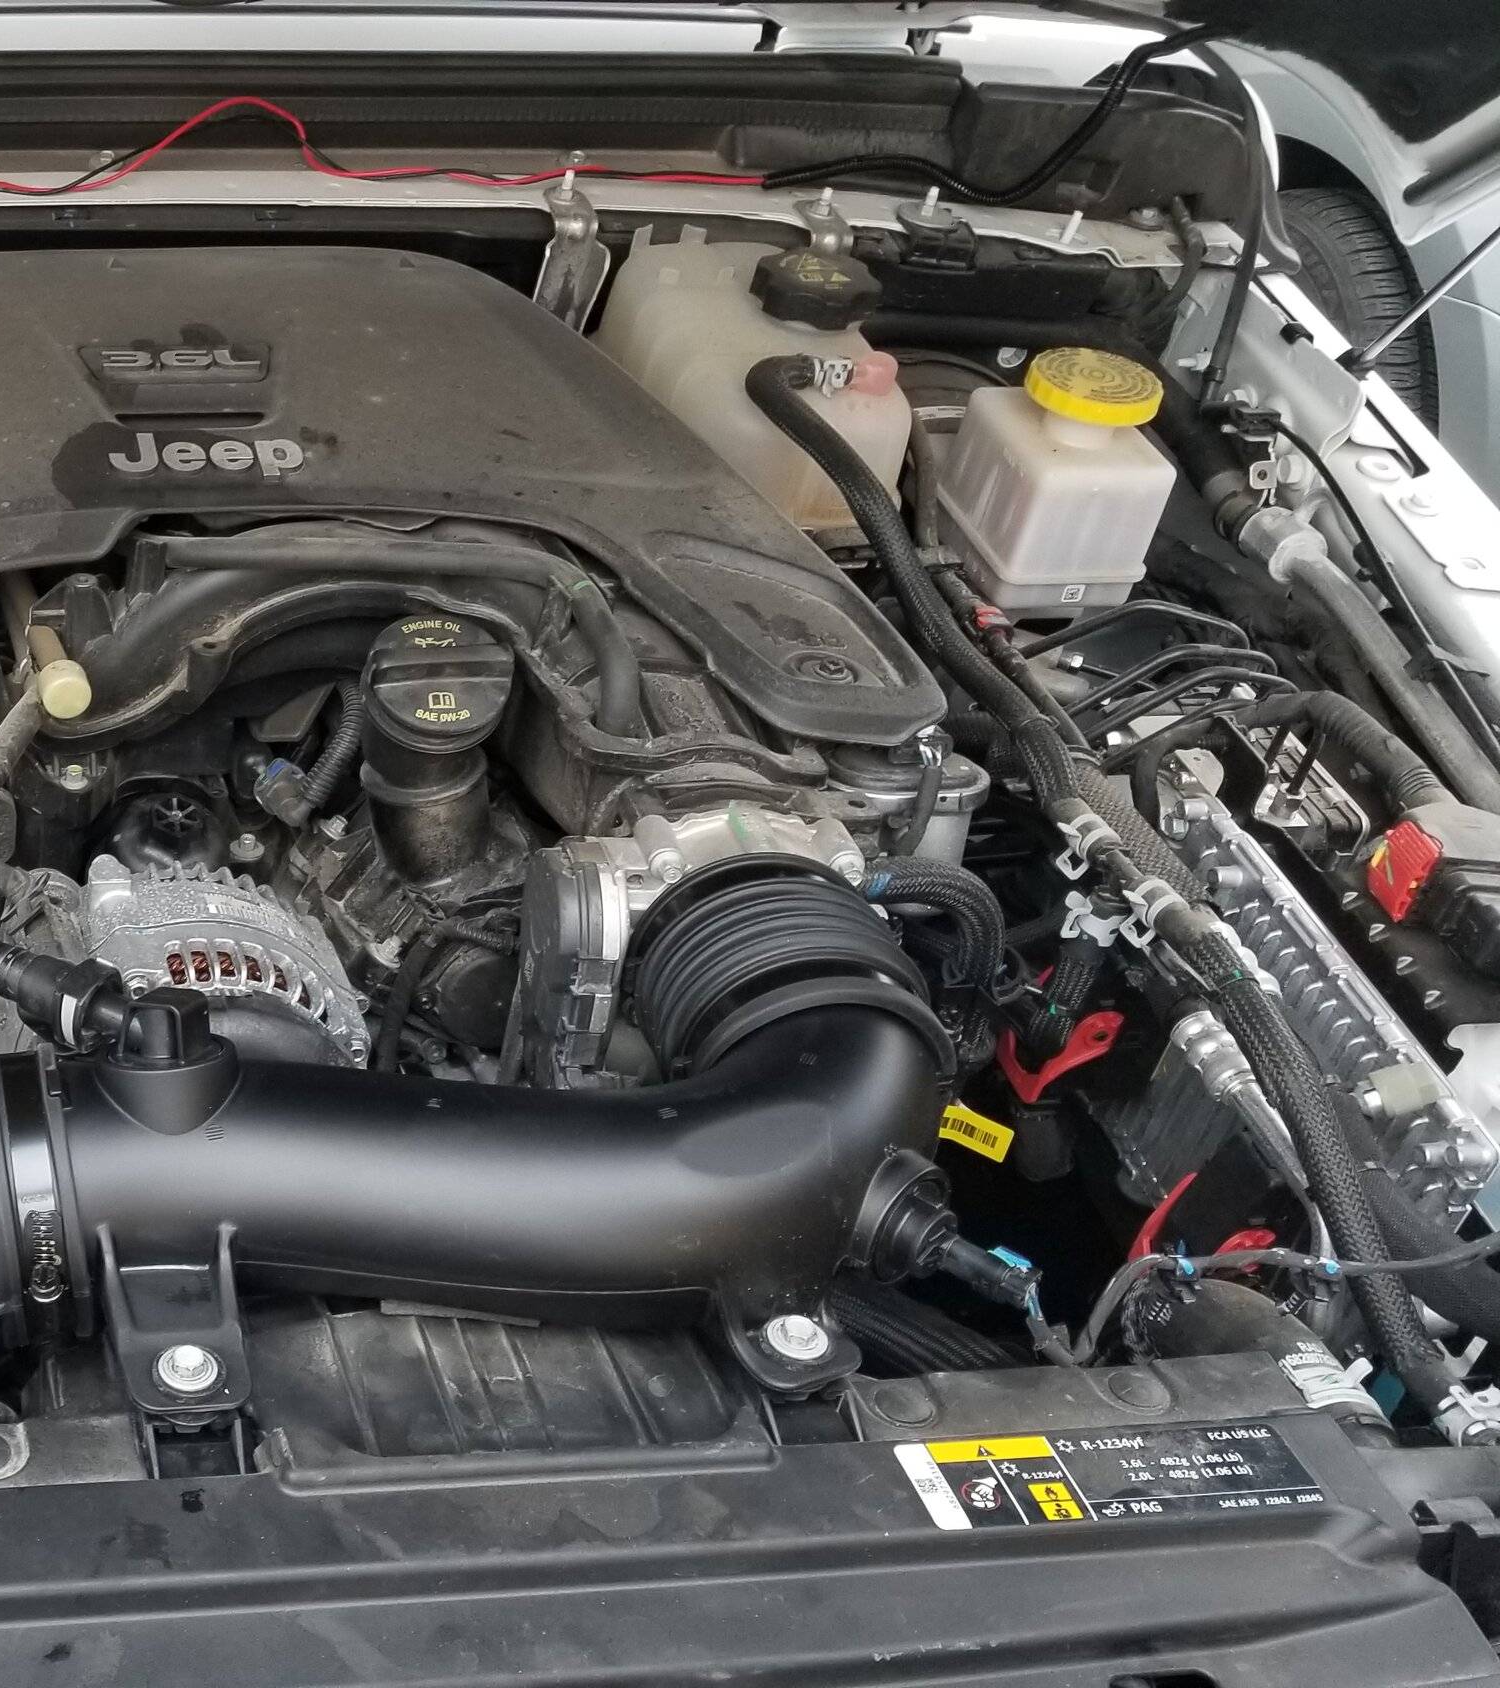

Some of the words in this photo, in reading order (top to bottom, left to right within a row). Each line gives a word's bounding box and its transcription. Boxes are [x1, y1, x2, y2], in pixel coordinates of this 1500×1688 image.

[108, 432, 304, 477] Jeep
[401, 620, 442, 634] ENGINE
[444, 620, 463, 633] OIL
[414, 709, 438, 721] SAE
[440, 709, 471, 722] 0W-20
[1207, 1431, 1232, 1441] FCA
[1231, 1429, 1250, 1439] US
[1249, 1428, 1271, 1438] LLC
[1080, 1436, 1145, 1451] R-1234yf
[1130, 1501, 1163, 1513] PAG
